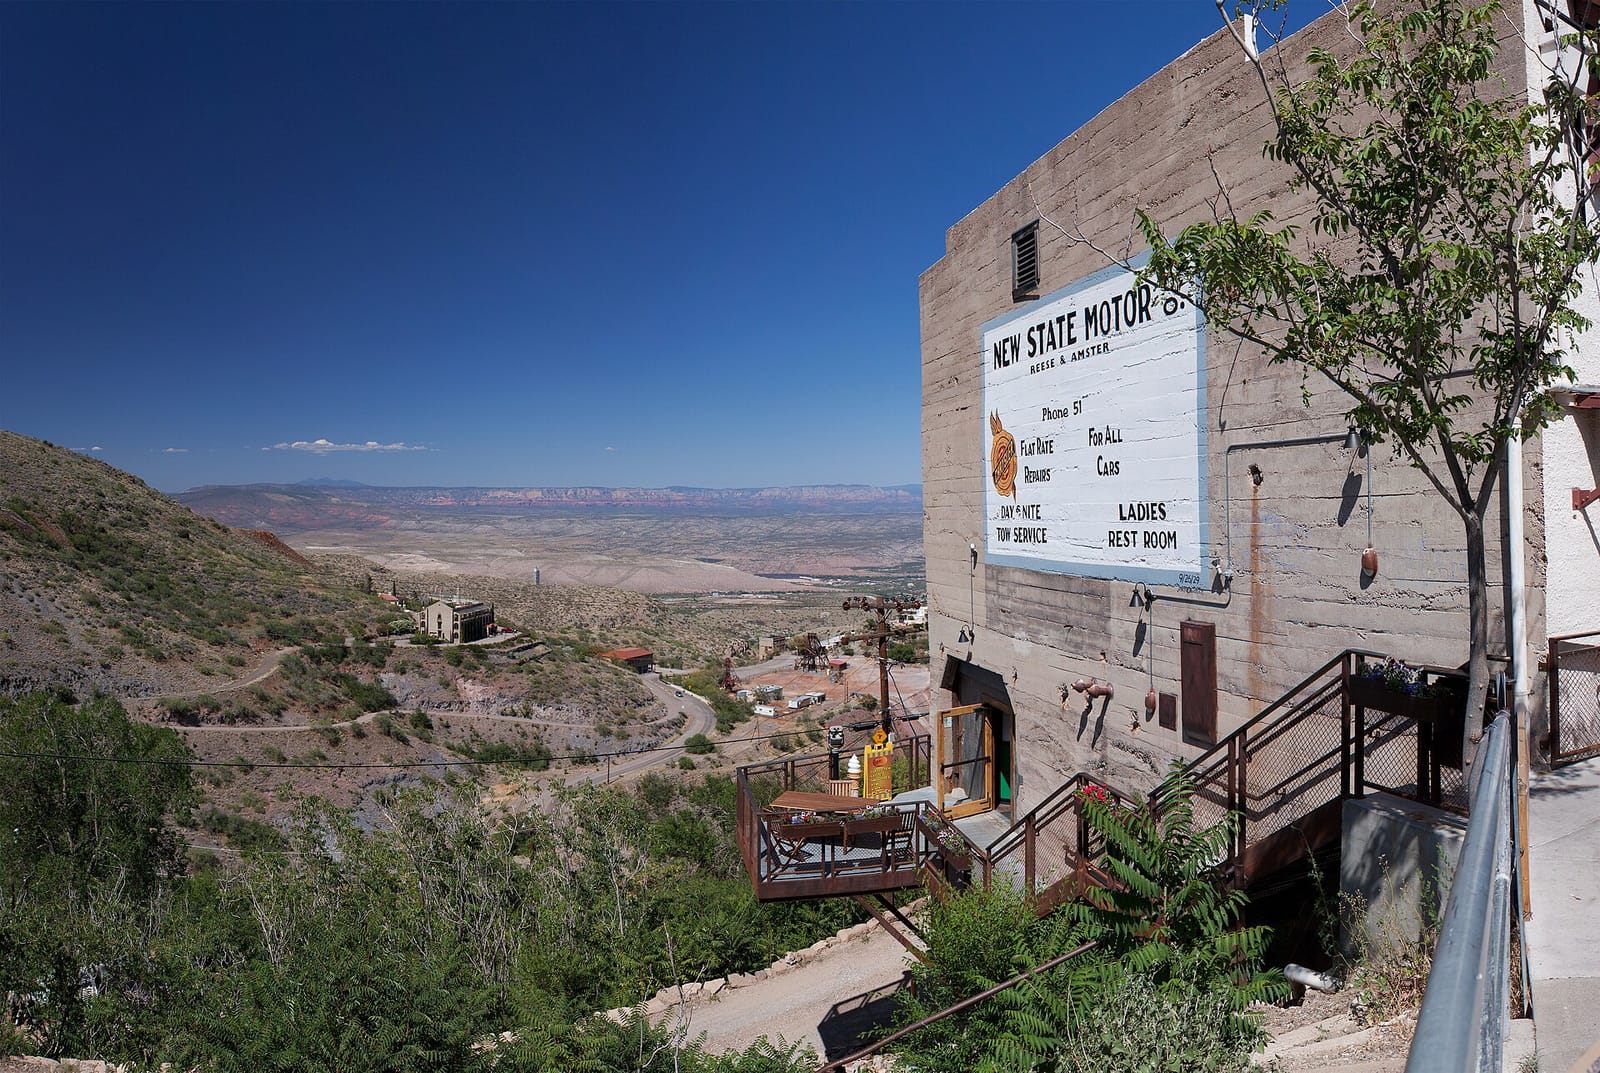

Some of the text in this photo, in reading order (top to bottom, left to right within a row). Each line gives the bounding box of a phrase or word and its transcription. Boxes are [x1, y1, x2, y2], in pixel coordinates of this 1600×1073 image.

[993, 333, 1022, 370] NEW
[1027, 310, 1077, 359] STATE
[1084, 284, 1151, 341] MOTOR
[1030, 342, 1109, 375] REESE & AMSTER
[1042, 400, 1081, 421] Phone 51
[1001, 505, 1014, 519] DAY
[1022, 504, 1041, 519] NITE
[1119, 502, 1166, 521] LADIES
[996, 527, 1047, 543] TOW SERVICE
[1108, 530, 1177, 549] REST ROOM
